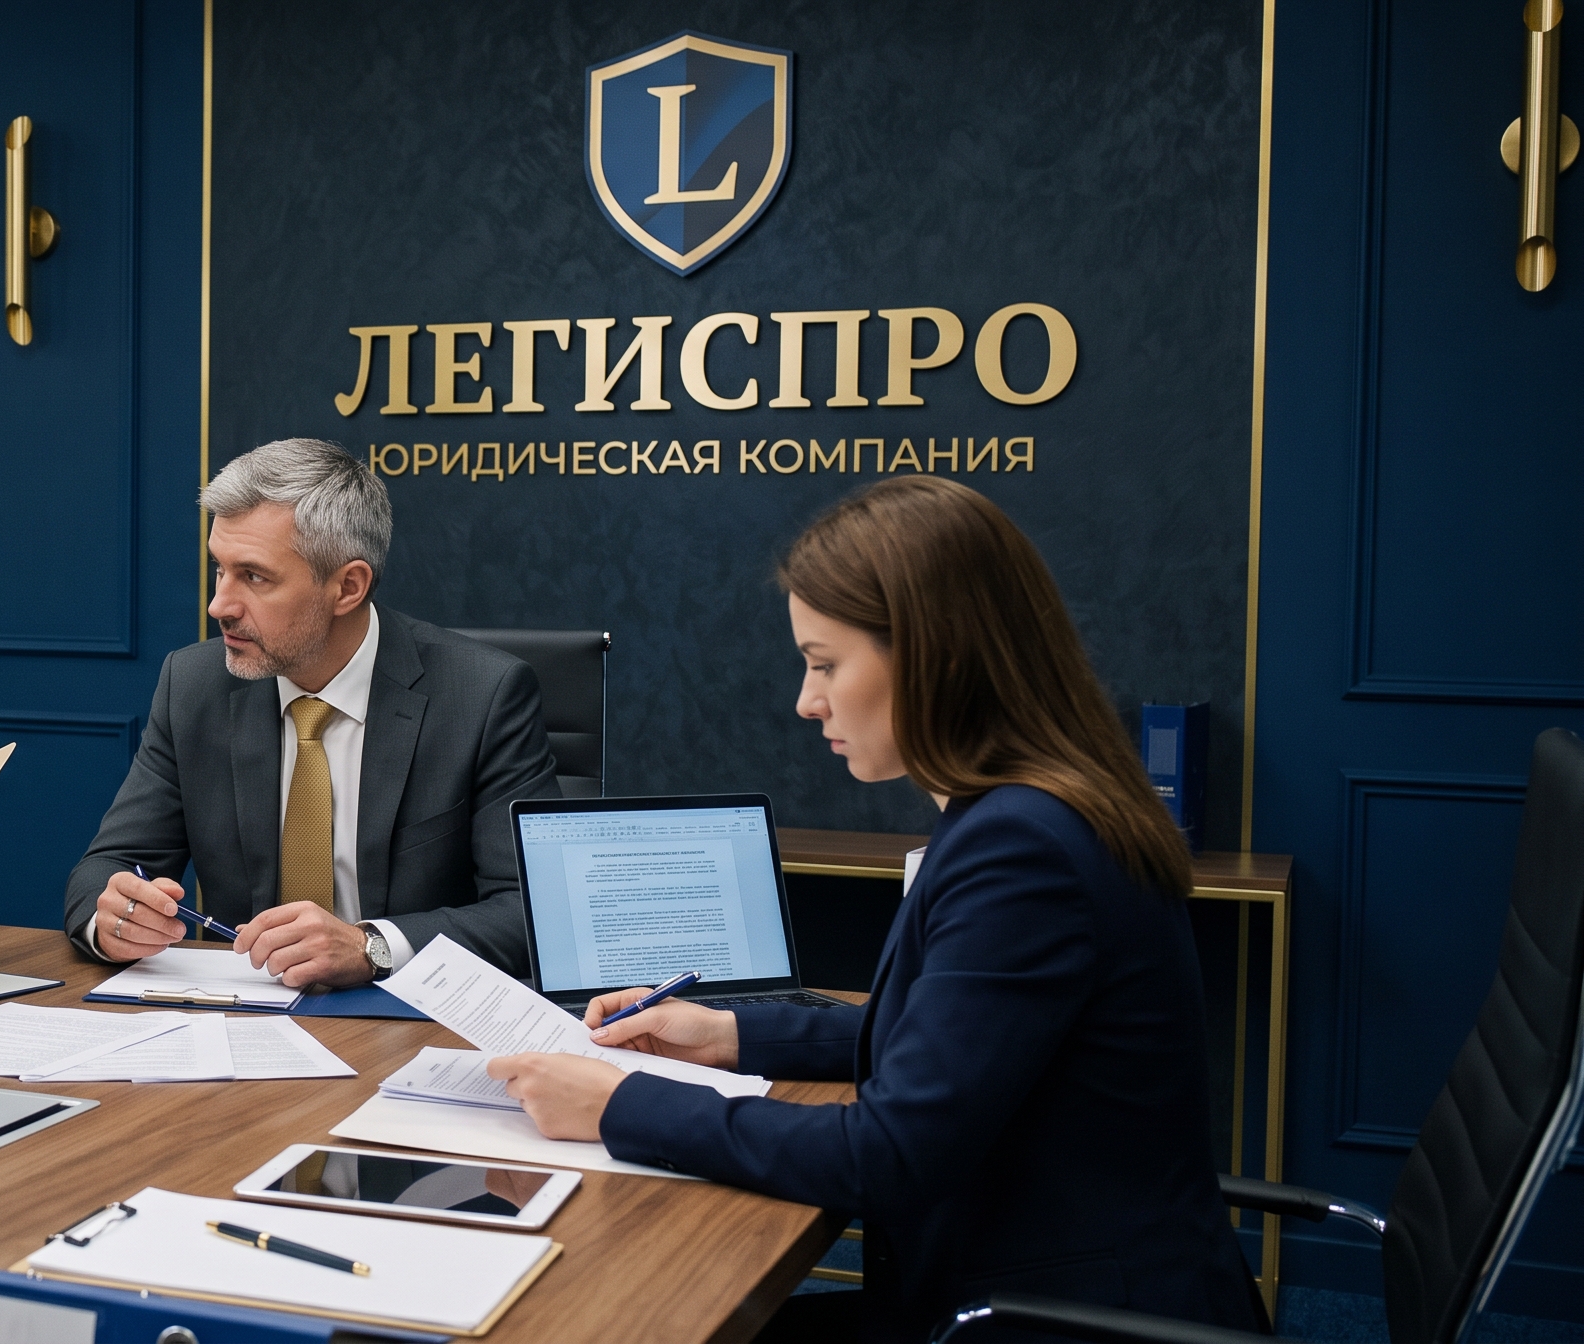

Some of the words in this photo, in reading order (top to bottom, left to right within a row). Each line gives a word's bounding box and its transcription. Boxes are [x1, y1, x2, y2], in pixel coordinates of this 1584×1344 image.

[643, 83, 738, 205] L
[333, 302, 1079, 418] ЛЕГИСПРО
[368, 441, 721, 482] ЮРИДИЧЕСКАЯ
[739, 436, 1037, 475] КОМПАНИЯ
